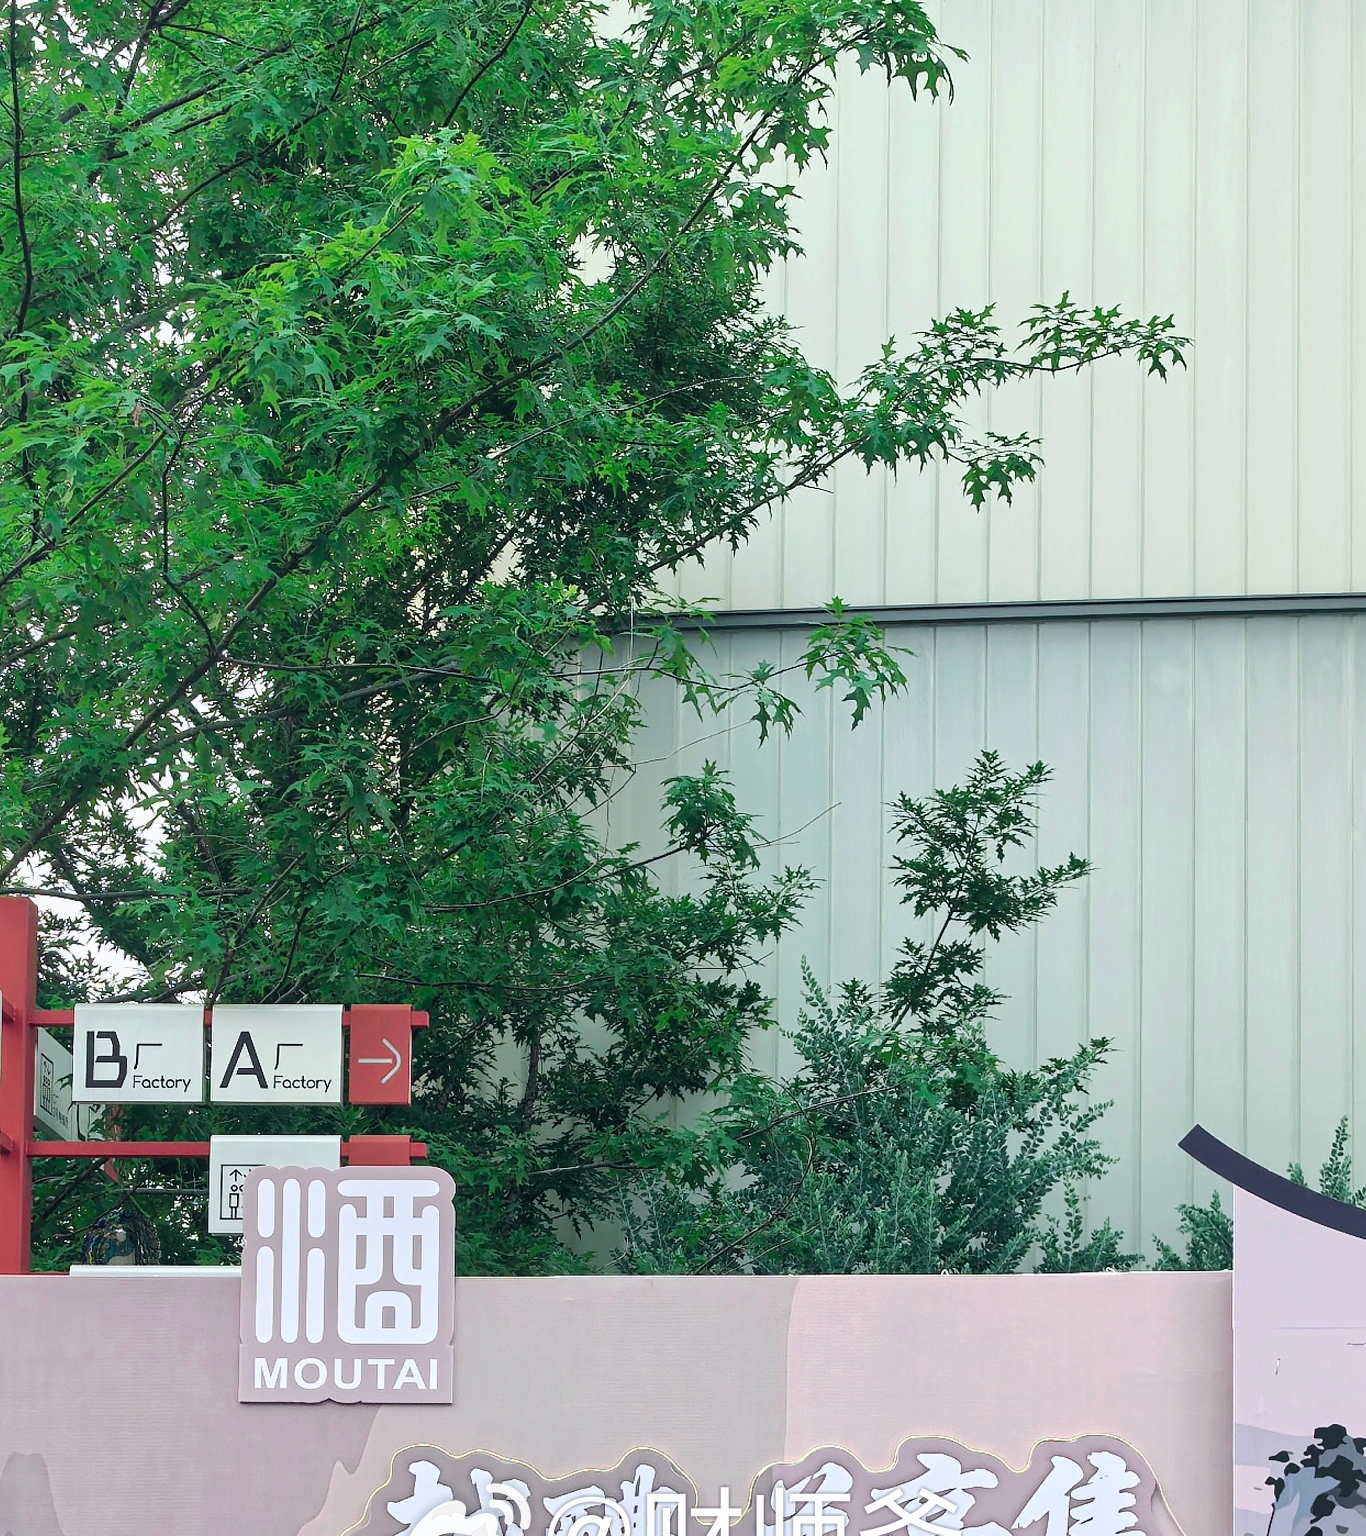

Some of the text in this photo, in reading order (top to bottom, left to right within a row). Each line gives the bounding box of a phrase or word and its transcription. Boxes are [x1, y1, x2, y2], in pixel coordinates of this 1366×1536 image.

[133, 1075, 191, 1092] Factory
[273, 1075, 332, 1092] Factory
[253, 1357, 439, 1390] MOUTAI
